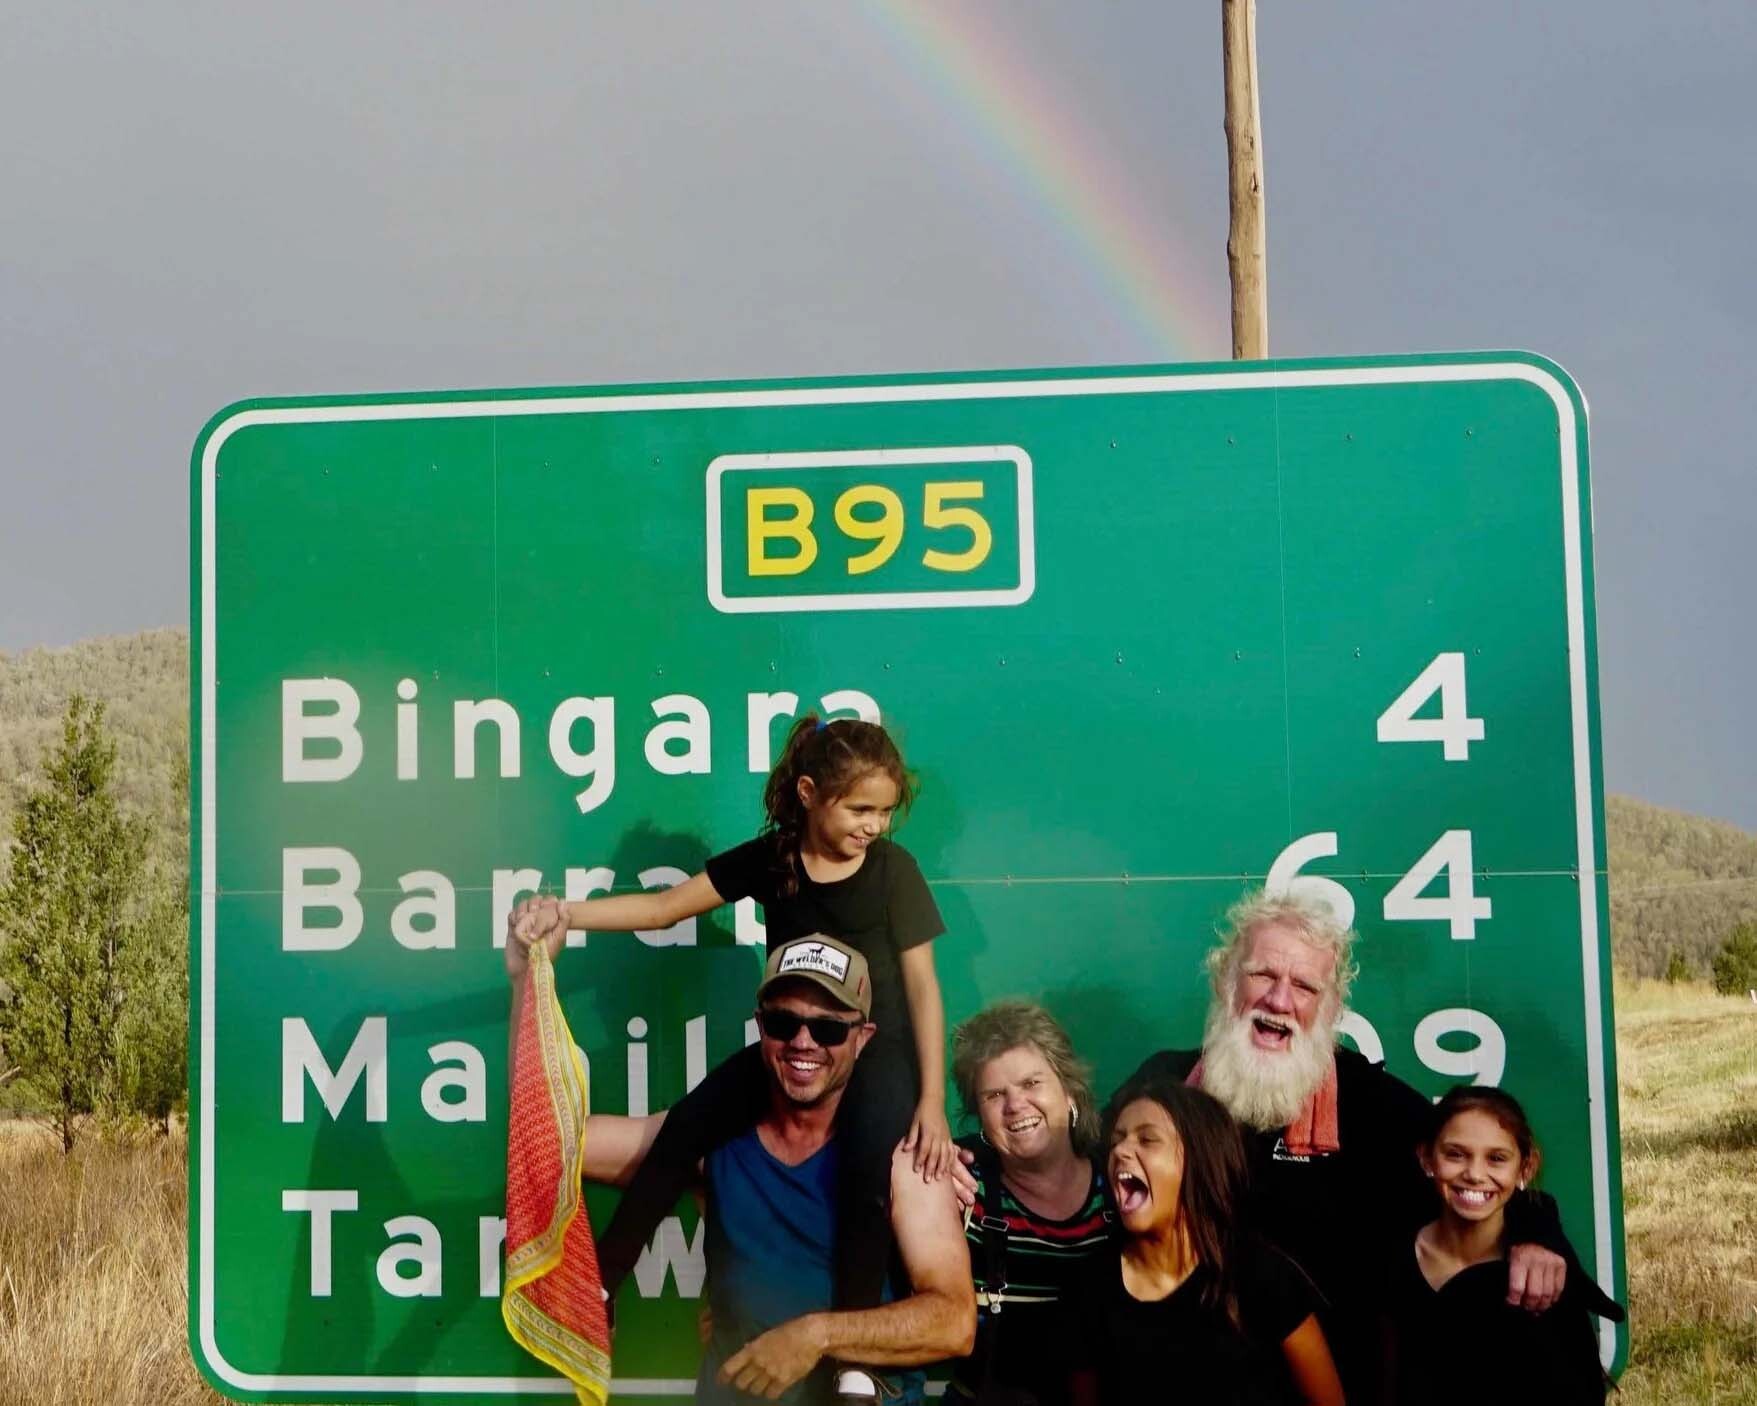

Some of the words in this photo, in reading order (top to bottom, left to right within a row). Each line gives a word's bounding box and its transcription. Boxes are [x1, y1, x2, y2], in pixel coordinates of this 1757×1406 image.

[747, 481, 992, 576] B95
[1377, 652, 1485, 761] 4
[1264, 830, 1492, 940] 64
